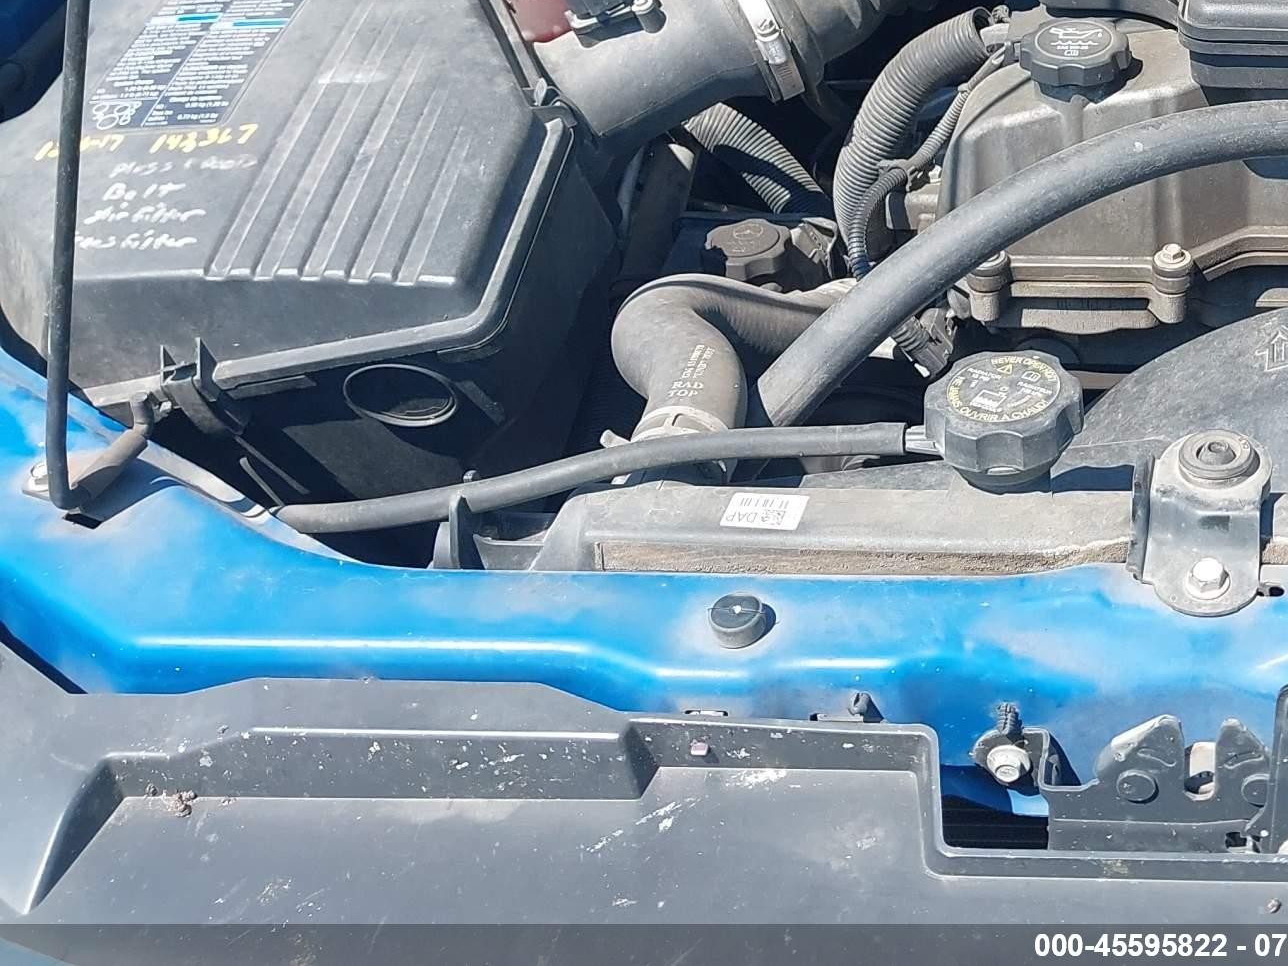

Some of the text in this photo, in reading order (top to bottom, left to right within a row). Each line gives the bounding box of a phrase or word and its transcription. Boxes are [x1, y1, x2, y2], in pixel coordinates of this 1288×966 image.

[991, 355, 1024, 365] NEVER
[671, 381, 704, 389] RAD
[667, 389, 699, 397] TOP
[959, 406, 999, 421] OUVRIR
